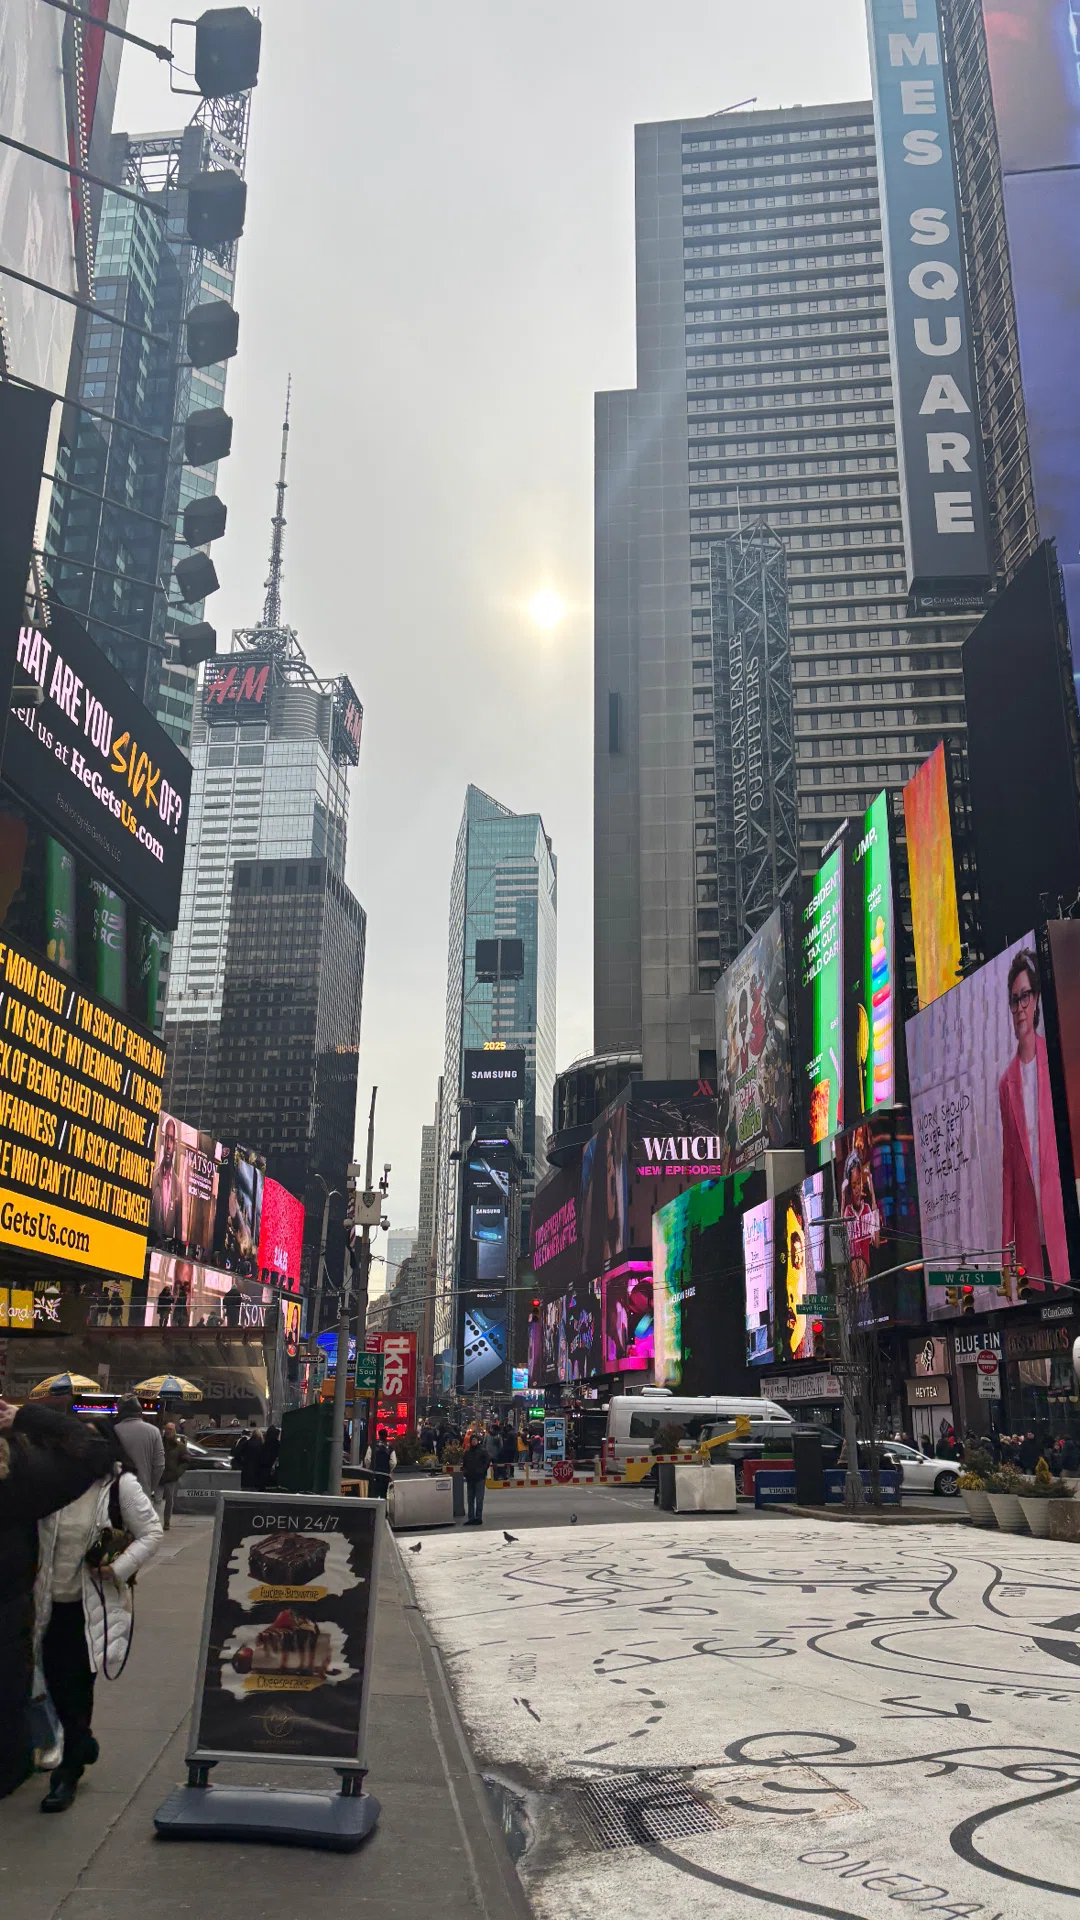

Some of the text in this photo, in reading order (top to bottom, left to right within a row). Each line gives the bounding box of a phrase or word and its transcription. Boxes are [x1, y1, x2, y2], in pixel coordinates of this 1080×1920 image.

[908, 207, 975, 534] SQUARE
[205, 665, 270, 705] H&M
[50, 656, 84, 726] ARE
[84, 688, 113, 757] YOU
[111, 732, 160, 808] SICK
[159, 779, 182, 834] OF?
[38, 722, 53, 749] us
[55, 741, 69, 765] at
[70, 747, 164, 863] HeGetsUs.com
[853, 827, 877, 865] UMP,
[802, 869, 840, 922] RESIDENT
[802, 910, 832, 949] AMILIES
[5, 949, 38, 998] MOM
[37, 970, 67, 1015] GUILT
[92, 1007, 115, 1047] SICK
[114, 1021, 127, 1053] OF
[125, 1029, 151, 1071] BEING
[25, 1009, 53, 1053] SICK
[51, 1025, 67, 1059] OF
[65, 1033, 84, 1070] MY
[82, 1043, 123, 1092] DEMONS
[483, 1041, 507, 1050] 2025
[471, 1070, 518, 1079] SAMSUNG
[10, 1049, 28, 1085] OF
[26, 1057, 61, 1103] BEING
[60, 1074, 91, 1118] GLUED
[91, 1090, 104, 1124] TO
[102, 1097, 120, 1132] MY
[118, 1105, 147, 1146] PHONE
[85, 1131, 108, 1169] SICK
[107, 1141, 120, 1174] OF
[118, 1147, 150, 1188] HAVING
[642, 1136, 721, 1160] WATCH
[10, 1144, 39, 1187] WHO
[38, 1156, 71, 1198] CAN'T
[69, 1168, 101, 1209] LAUGH
[100, 1181, 113, 1213] AT
[637, 1165, 662, 1176] NEW
[0, 1202, 90, 1253] GetsUs.com
[945, 1274, 984, 1283] W 47 St
[955, 1335, 979, 1353] BLUE
[983, 1332, 1001, 1349] FIN
[383, 1336, 410, 1396] tkts
[915, 1386, 938, 1398] HEYTEA
[554, 1467, 573, 1477] STOP
[252, 1515, 339, 1531] OPEN 24/7
